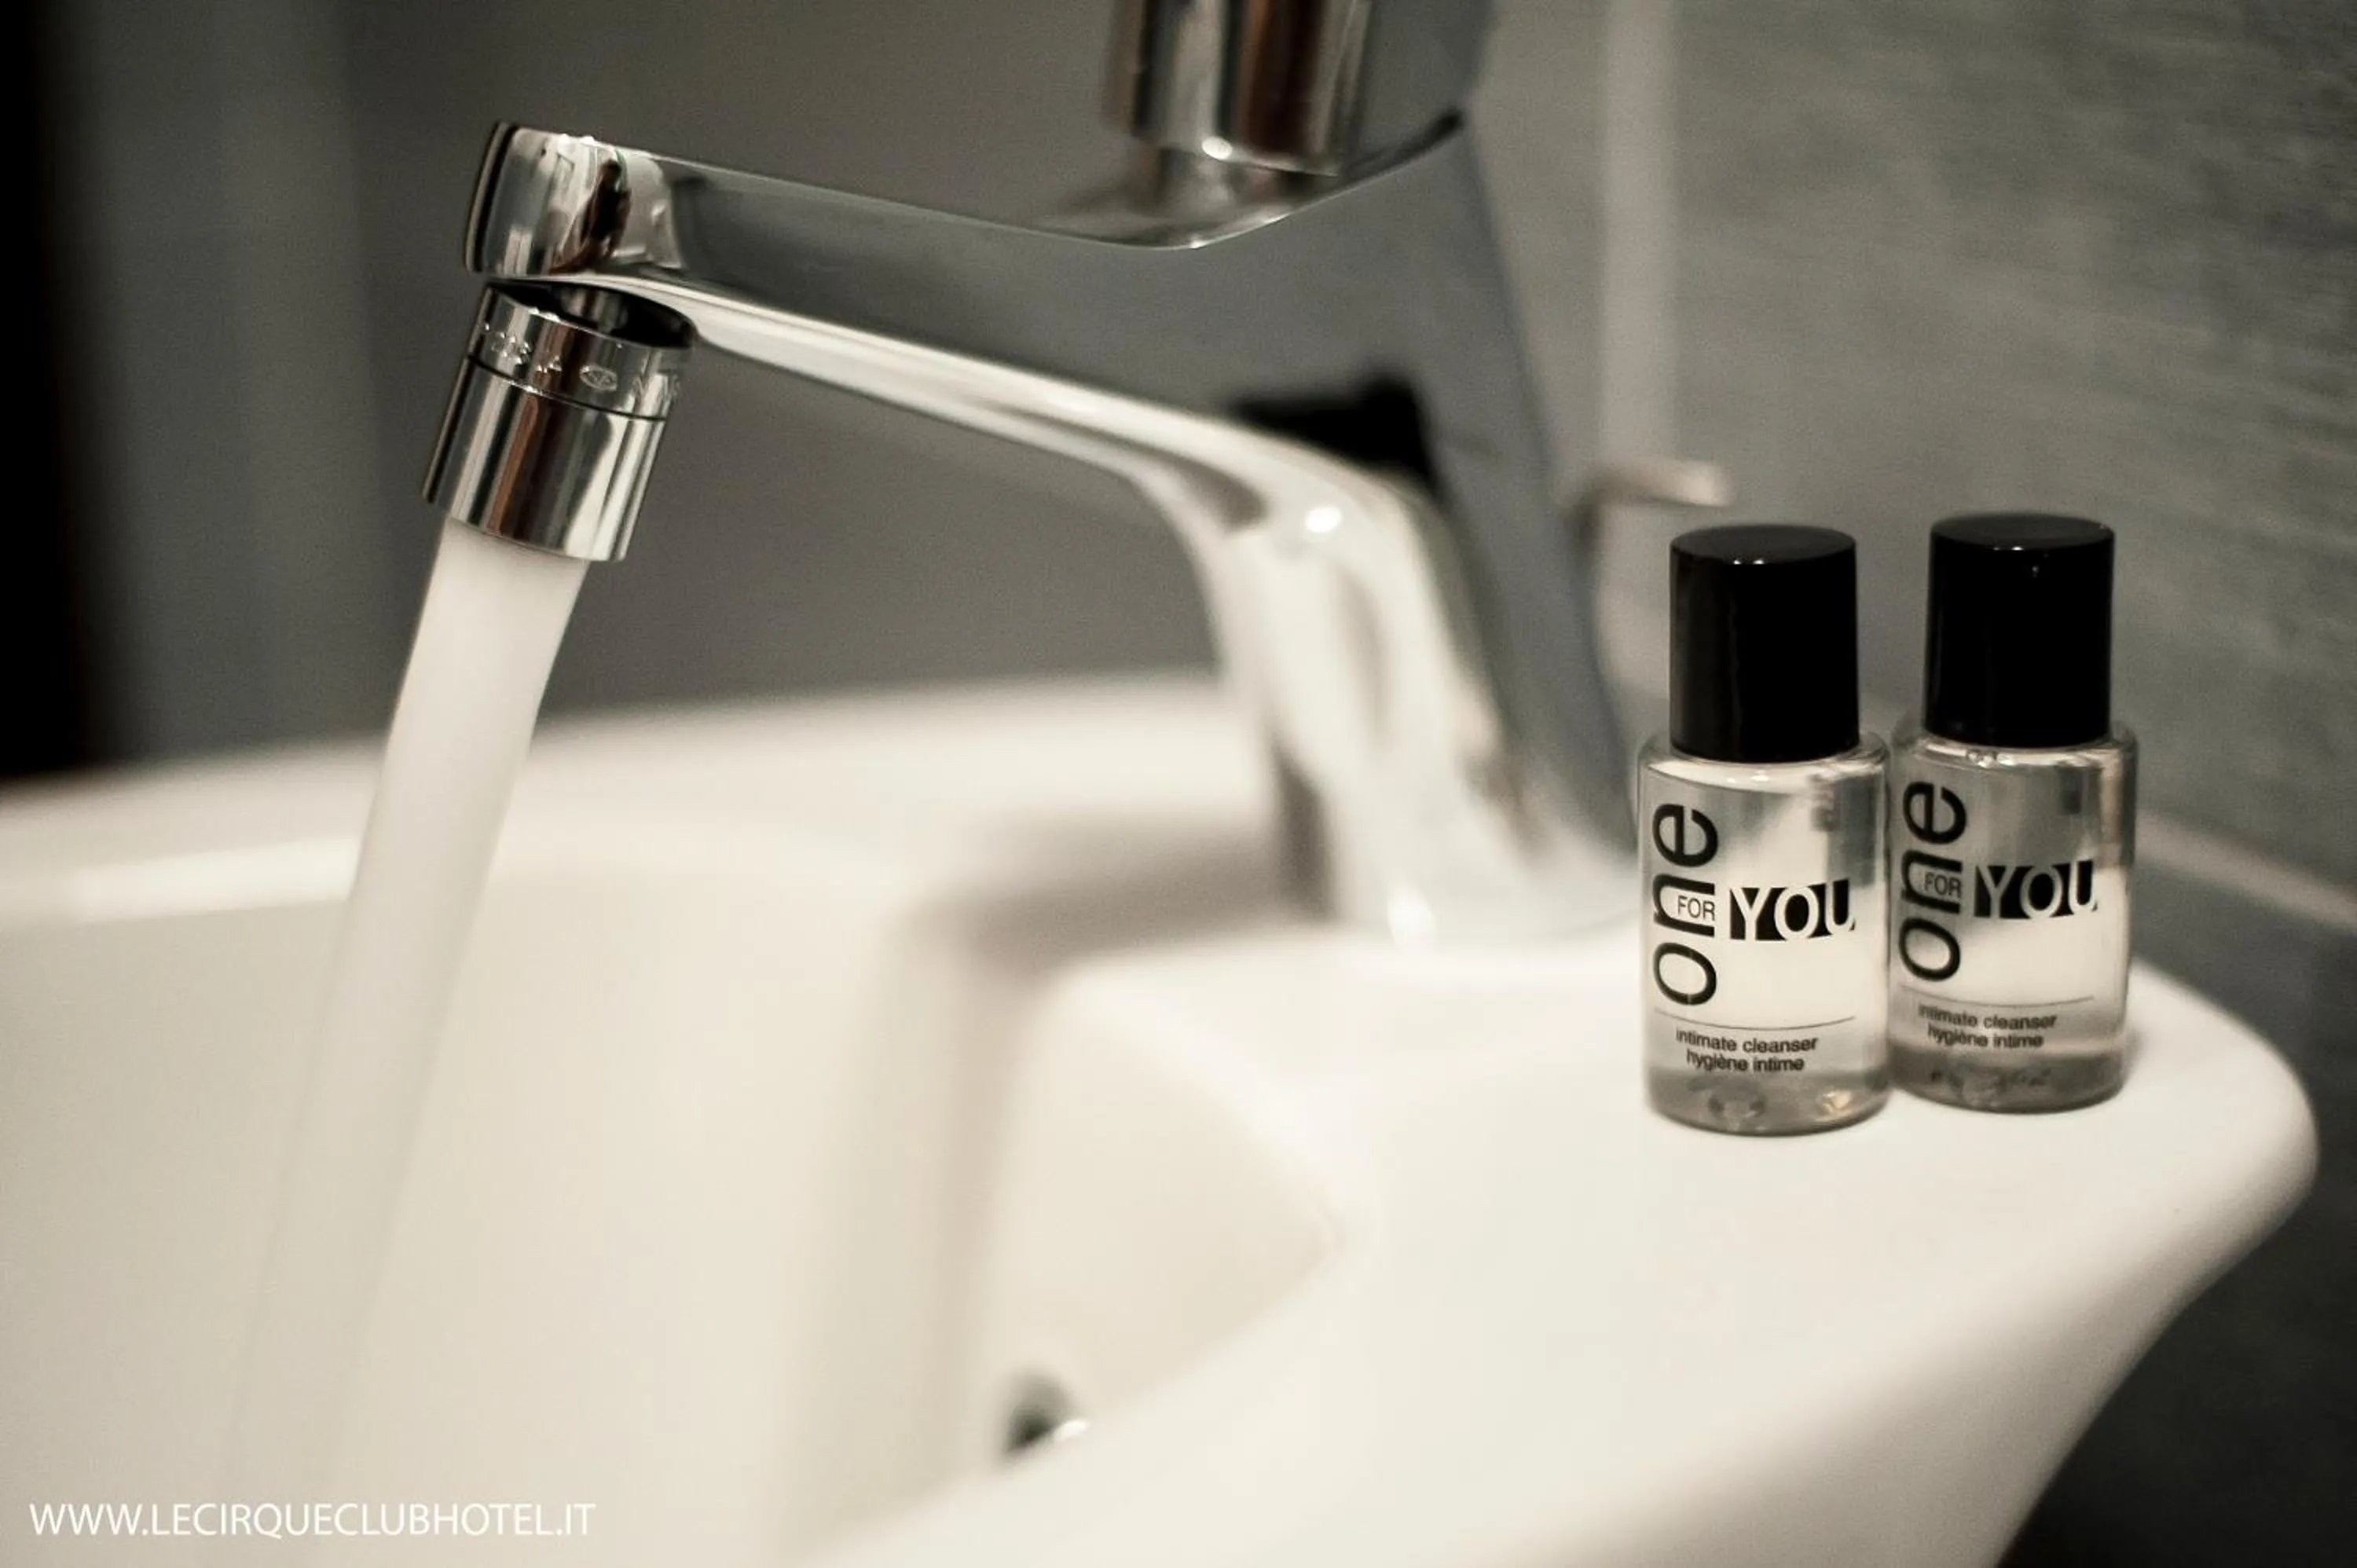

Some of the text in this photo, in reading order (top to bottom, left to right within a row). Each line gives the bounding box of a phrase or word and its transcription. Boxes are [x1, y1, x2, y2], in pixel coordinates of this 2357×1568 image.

[1899, 781, 1967, 981] one
[1924, 860, 2099, 919] FOR YOU
[1653, 803, 1718, 1006] one
[1677, 878, 1856, 941] FOR YOU
[1918, 1003, 2058, 1030] intimate cleanser
[1676, 1027, 1819, 1053] intimate cleanser
[1686, 1050, 1805, 1073] hygiène intime
[1993, 1032, 2044, 1049] intime
